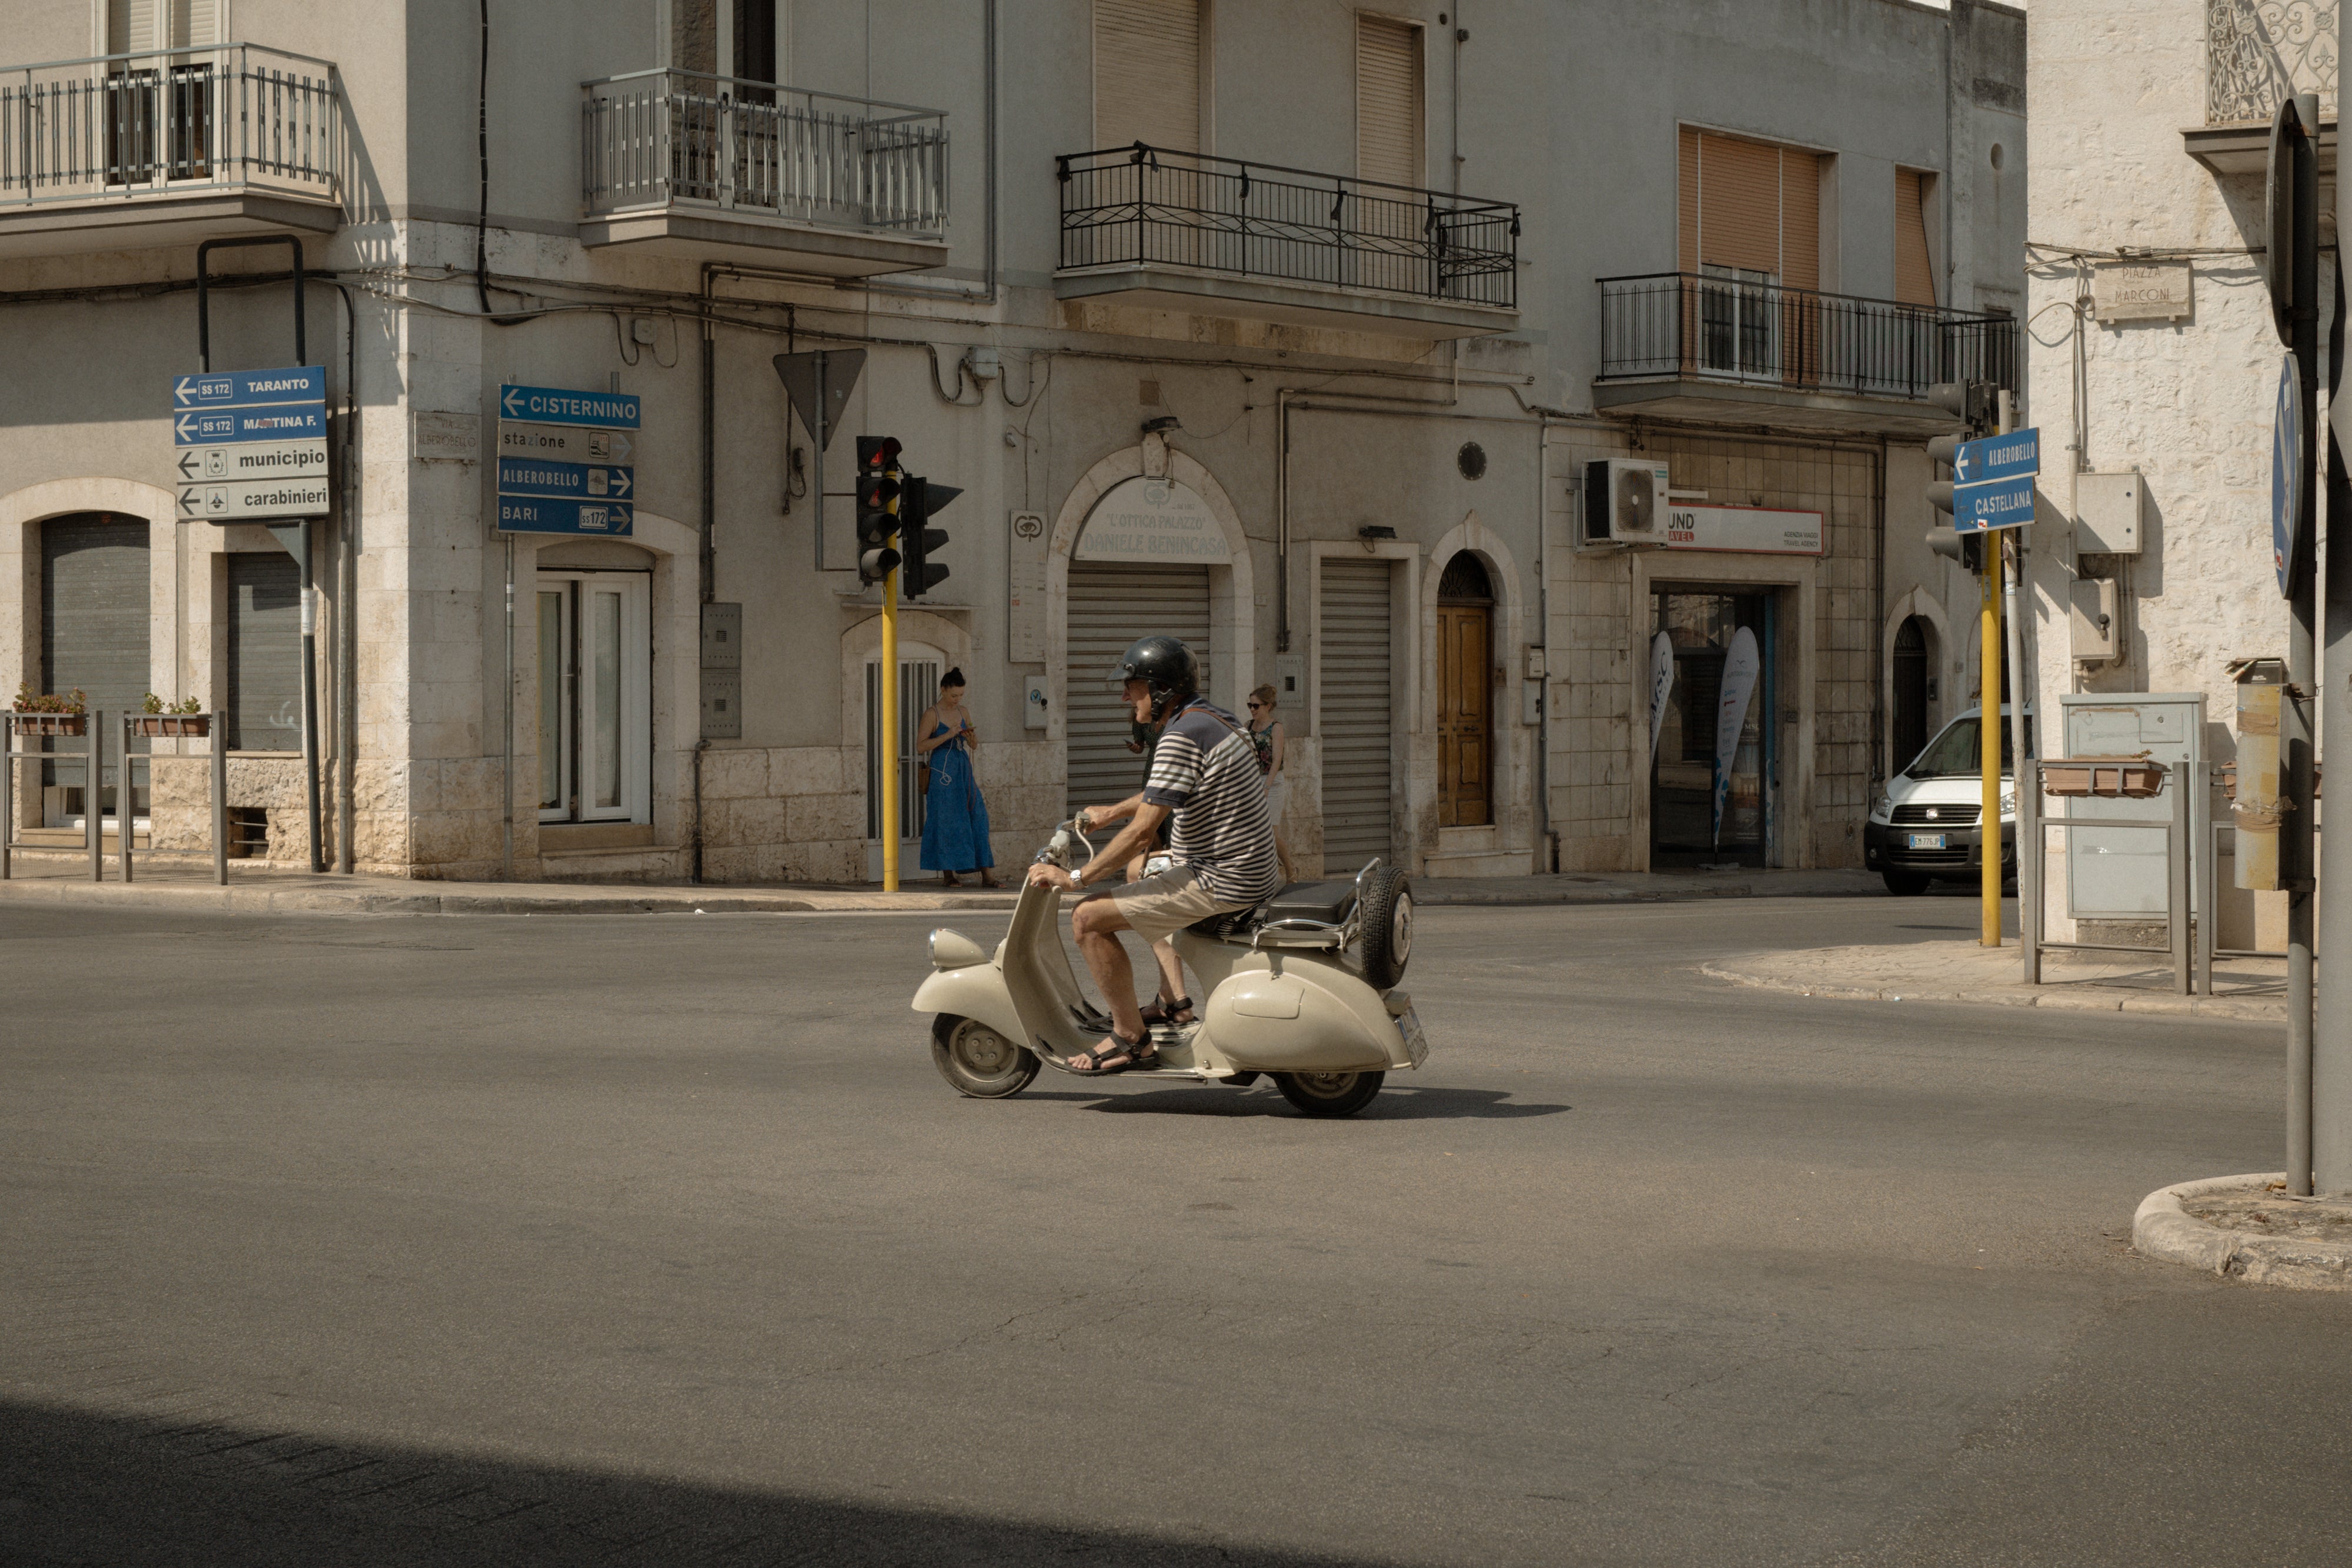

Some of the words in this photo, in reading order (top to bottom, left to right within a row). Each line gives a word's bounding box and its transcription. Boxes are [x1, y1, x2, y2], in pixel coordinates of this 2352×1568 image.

[2123, 266, 2160, 279] PIAZZA
[2115, 289, 2169, 302] MARCONI
[202, 385, 212, 394] SS
[215, 384, 229, 394] 172
[248, 379, 309, 393] TARANTO
[530, 396, 637, 419] CISTERNINO
[203, 422, 213, 431] SS
[216, 421, 230, 431] 172
[307, 416, 316, 426] F.
[504, 432, 565, 448] stazione
[239, 449, 325, 468] municipio
[1989, 442, 2035, 466] ALBEROBELLO
[503, 469, 579, 486] ALBEROBELLO
[245, 488, 326, 506] carabinieri
[1975, 490, 2032, 515] CASTELLANA
[503, 506, 537, 521] BARI
[1084, 533, 1144, 553] DANIELE
[1147, 535, 1227, 556] BENINCASA
